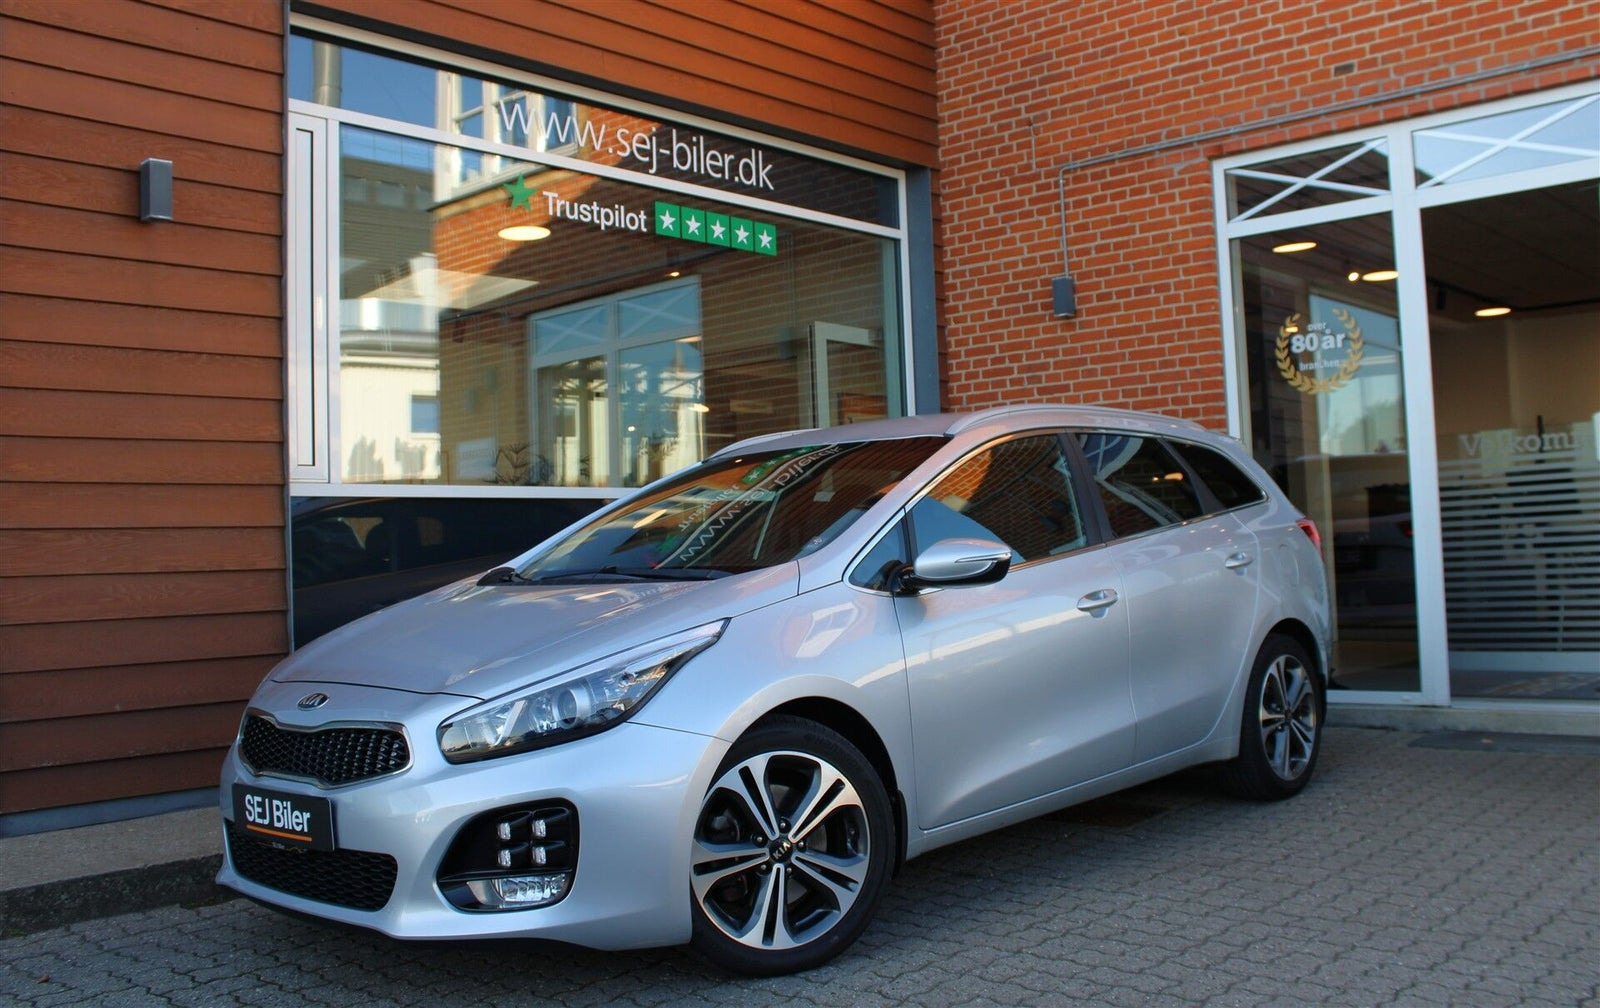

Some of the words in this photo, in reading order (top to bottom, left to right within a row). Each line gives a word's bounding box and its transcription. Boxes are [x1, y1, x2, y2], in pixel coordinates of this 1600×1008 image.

[499, 100, 775, 190] www.sej-biler.dk
[542, 191, 648, 233] Trustpilot
[1291, 333, 1319, 353] 80
[1321, 328, 1346, 349] år
[245, 794, 269, 825] SEJ
[273, 799, 311, 833] Biler
[772, 841, 792, 860] KIA
